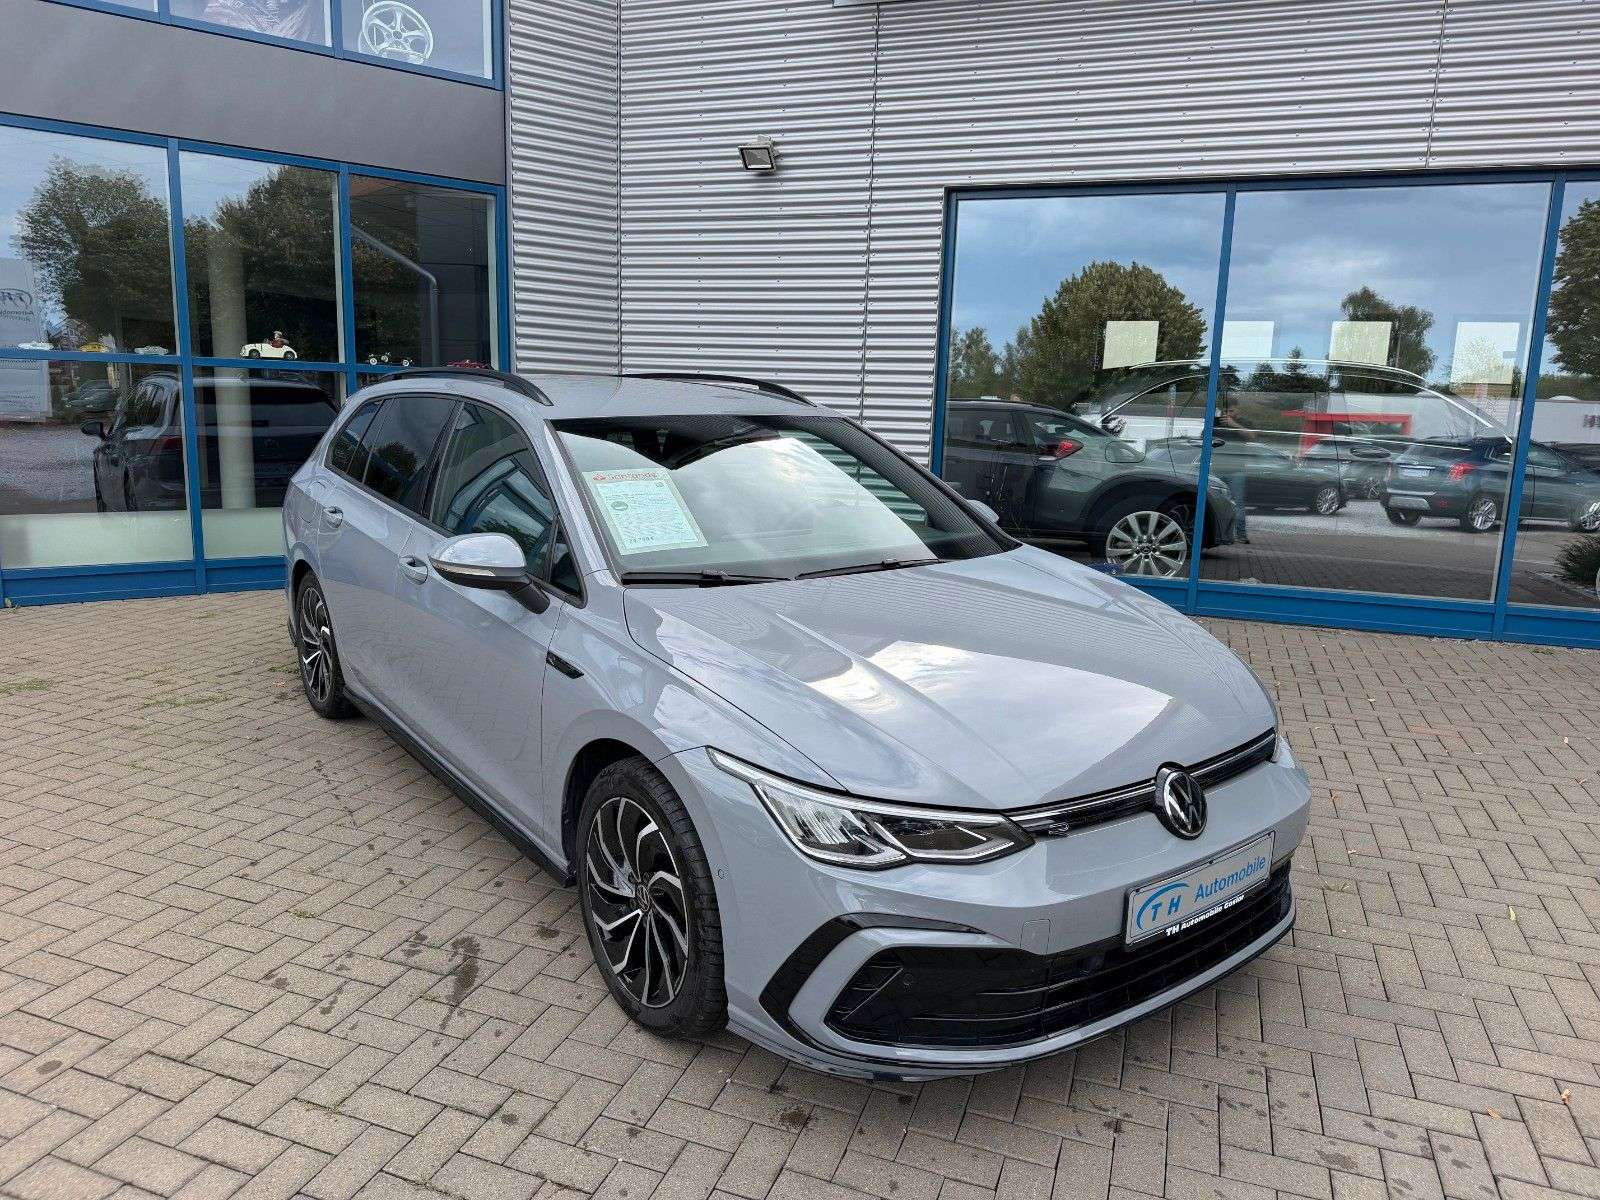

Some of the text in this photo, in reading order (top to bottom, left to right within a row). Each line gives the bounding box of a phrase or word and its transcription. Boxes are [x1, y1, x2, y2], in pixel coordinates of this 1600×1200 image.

[1194, 856, 1266, 903] Automobile
[1165, 924, 1180, 937] TH
[1181, 906, 1223, 930] Automobile
